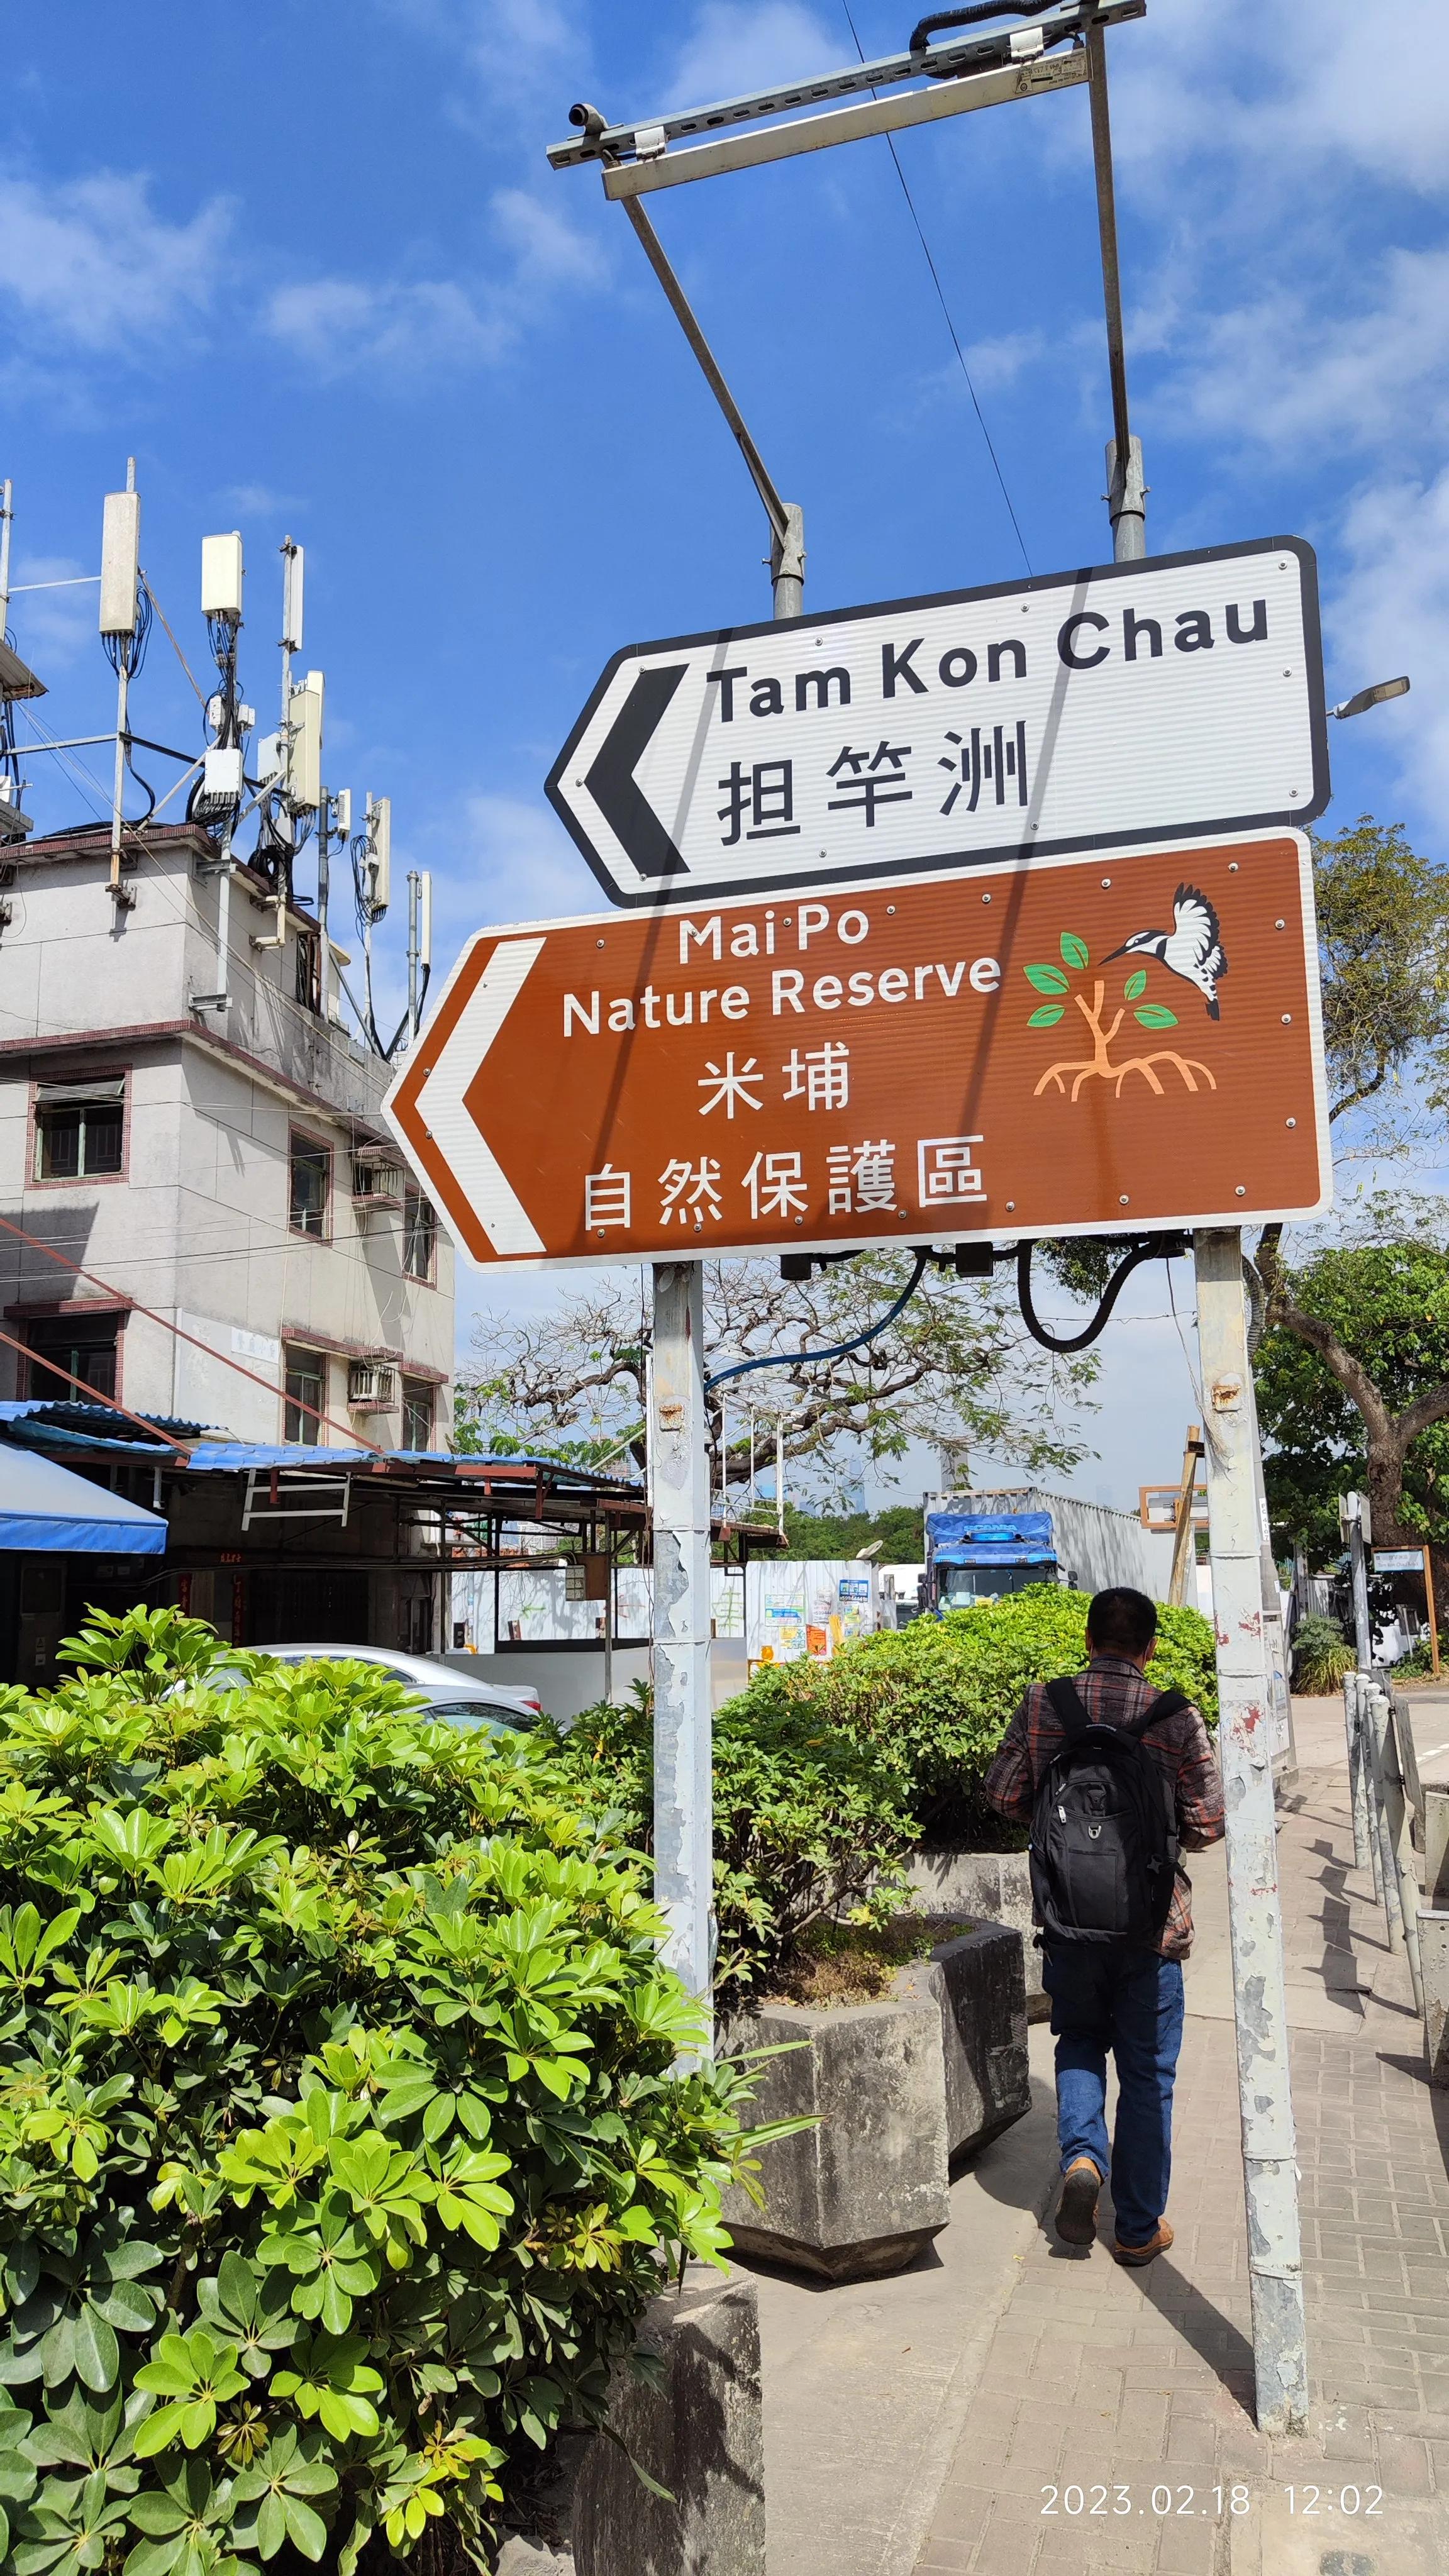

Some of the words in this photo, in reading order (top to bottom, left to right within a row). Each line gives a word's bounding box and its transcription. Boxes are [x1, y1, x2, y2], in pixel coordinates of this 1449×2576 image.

[706, 666, 851, 723] Tam
[882, 638, 1027, 699] Kon
[1057, 599, 1268, 670] Chau
[717, 720, 1028, 846] 担竿洲
[679, 910, 775, 964] Mai
[797, 904, 869, 950] Po
[564, 985, 750, 1037] Nature
[772, 957, 1001, 1016] Reserve
[697, 1041, 850, 1119] 米埔
[585, 1135, 987, 1231] 自然保護區
